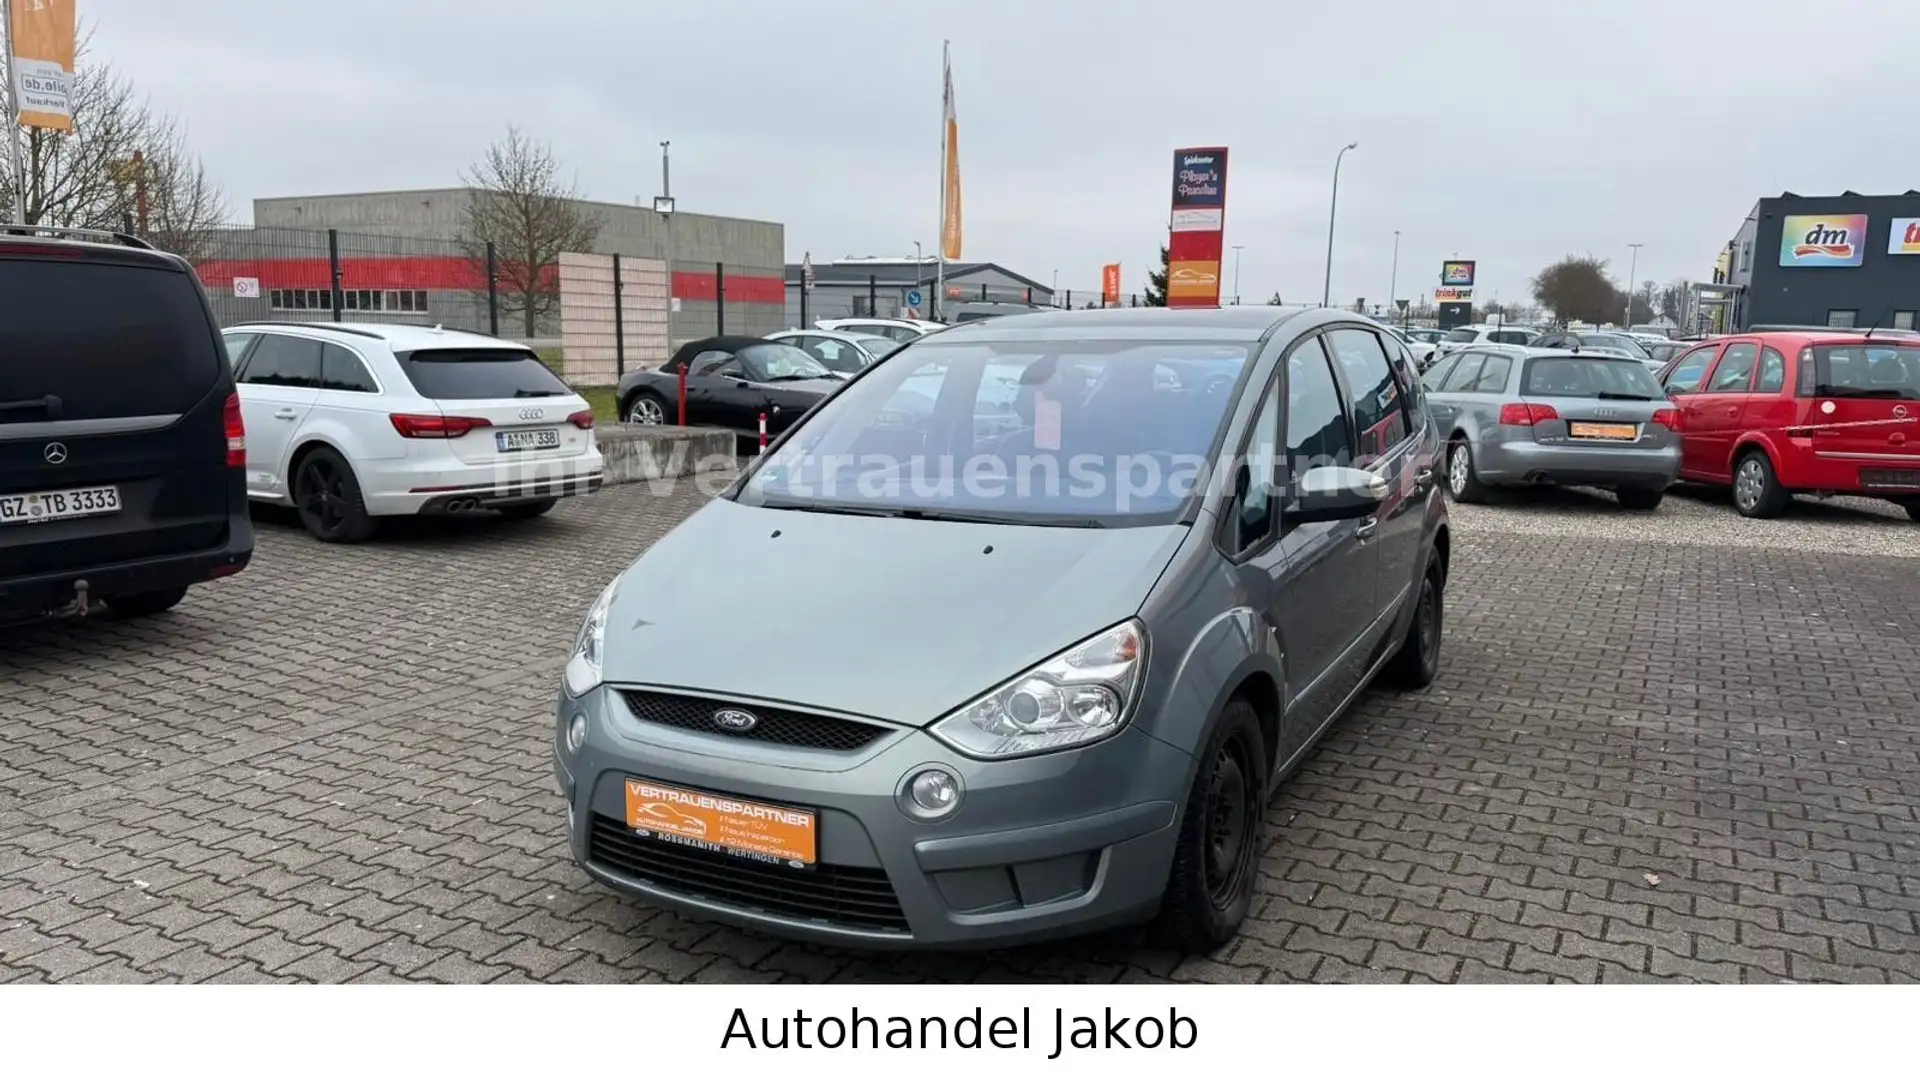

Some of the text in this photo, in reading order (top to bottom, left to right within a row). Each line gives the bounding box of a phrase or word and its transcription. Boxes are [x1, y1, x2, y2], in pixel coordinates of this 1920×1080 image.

[1805, 224, 1847, 245] dm
[1435, 288, 1473, 300] trinkgut
[1, 489, 117, 517] GZ TB 3333
[630, 784, 808, 827] VERTRAUENSPARTNER
[658, 832, 720, 852] ROSSMANITH
